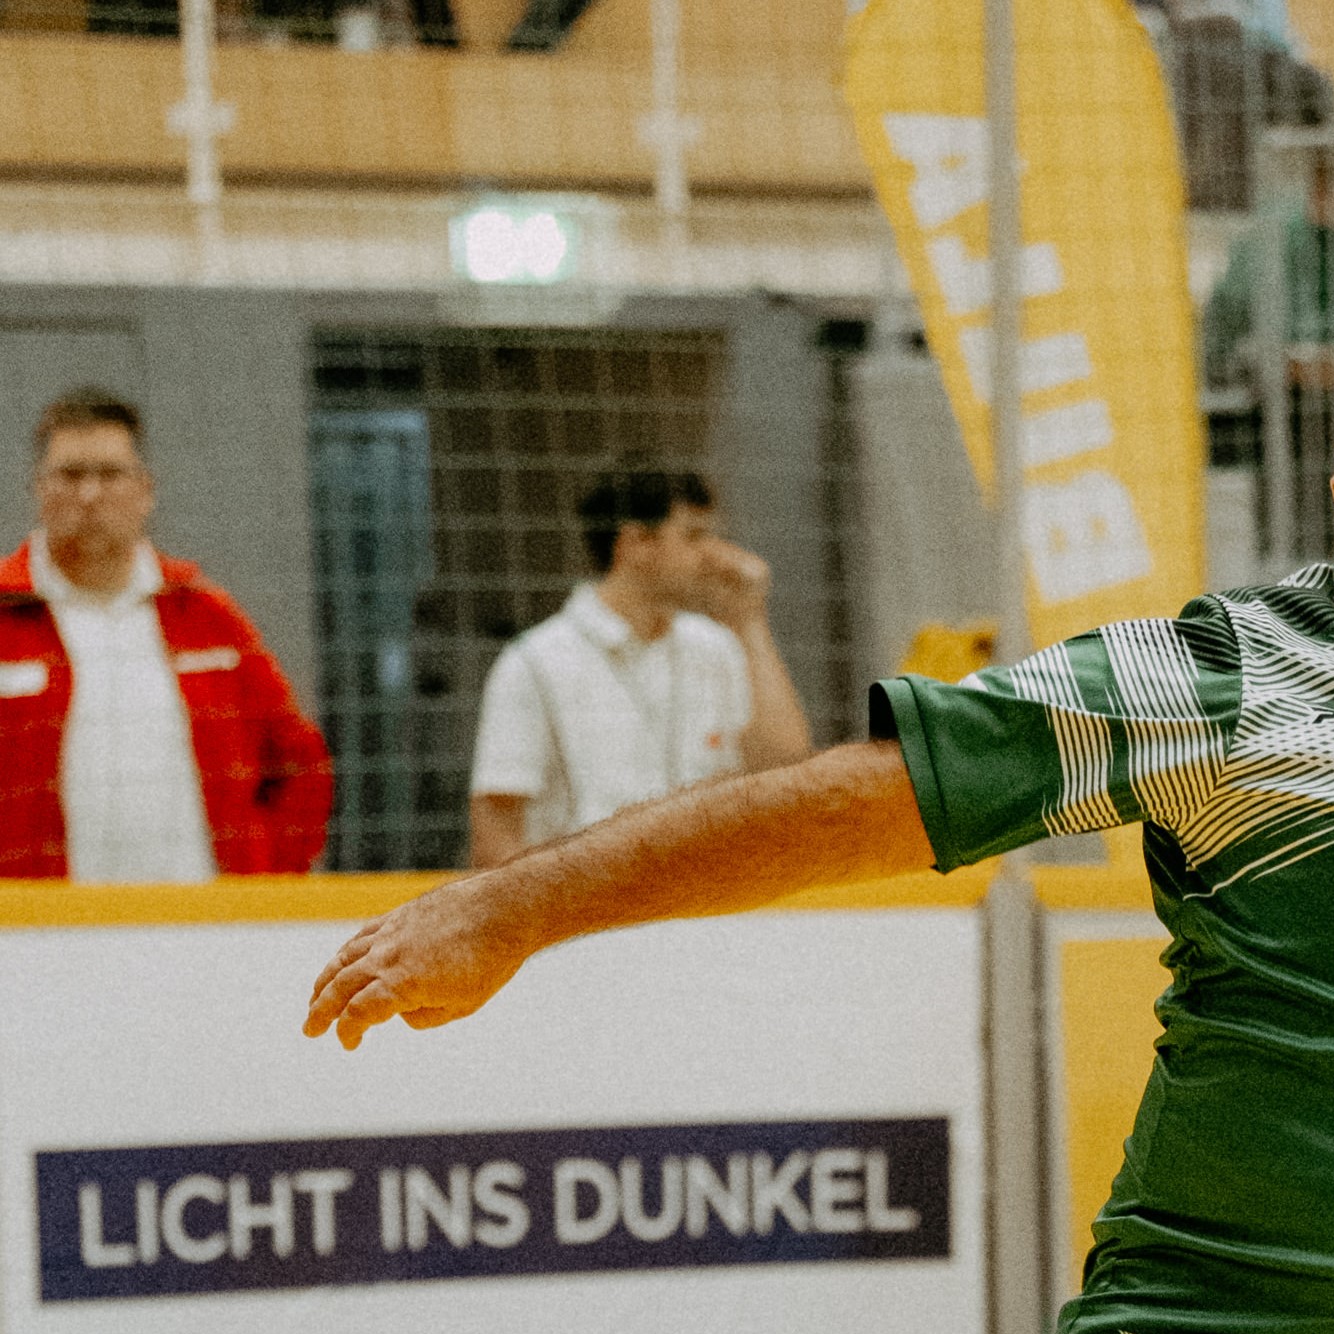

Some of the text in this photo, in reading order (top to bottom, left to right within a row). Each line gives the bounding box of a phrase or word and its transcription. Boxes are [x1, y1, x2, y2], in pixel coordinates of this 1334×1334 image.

[79, 1147, 921, 1269] LICHT INS DUNKEL
